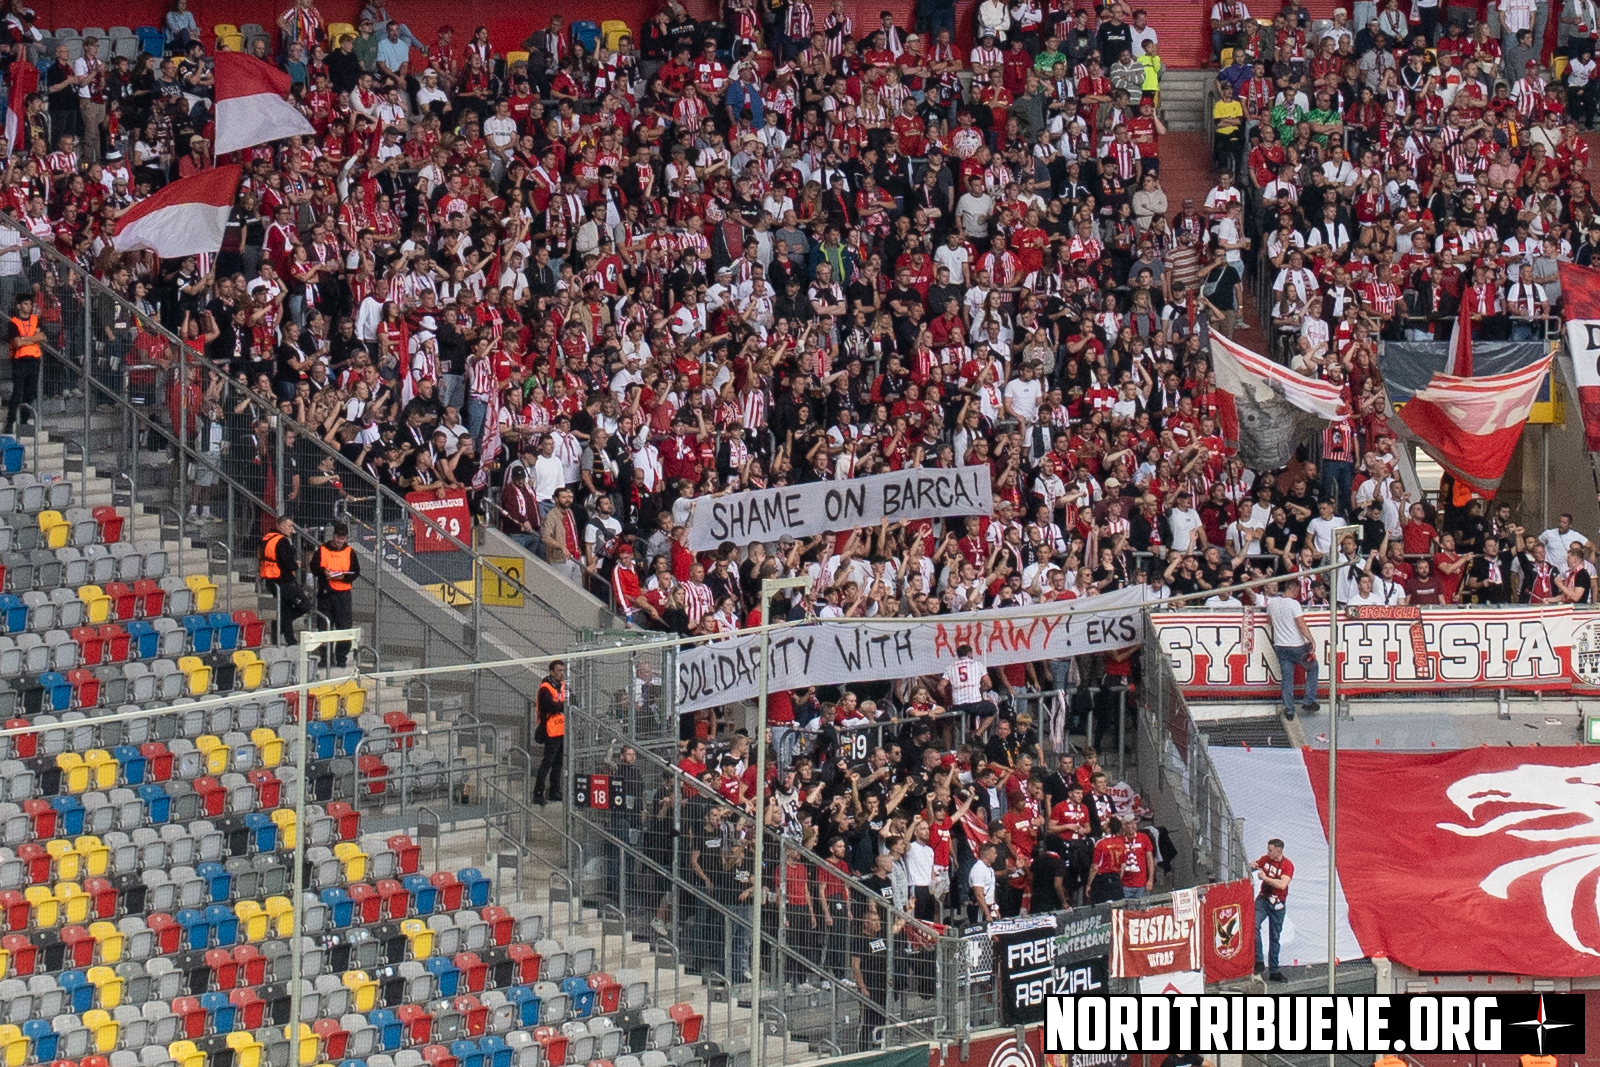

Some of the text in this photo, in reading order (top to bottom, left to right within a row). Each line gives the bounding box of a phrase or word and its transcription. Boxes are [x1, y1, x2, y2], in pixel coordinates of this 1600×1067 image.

[709, 491, 805, 541] SHAME
[824, 484, 867, 521] ON
[440, 583, 457, 605] 19
[498, 566, 521, 599] 19
[1085, 615, 1137, 645] EKS
[958, 665, 968, 682] 5
[850, 732, 867, 760] 19
[592, 789, 607, 804] 18
[1128, 914, 1190, 945] EKSTASE
[1147, 950, 1175, 968] ULTRAS
